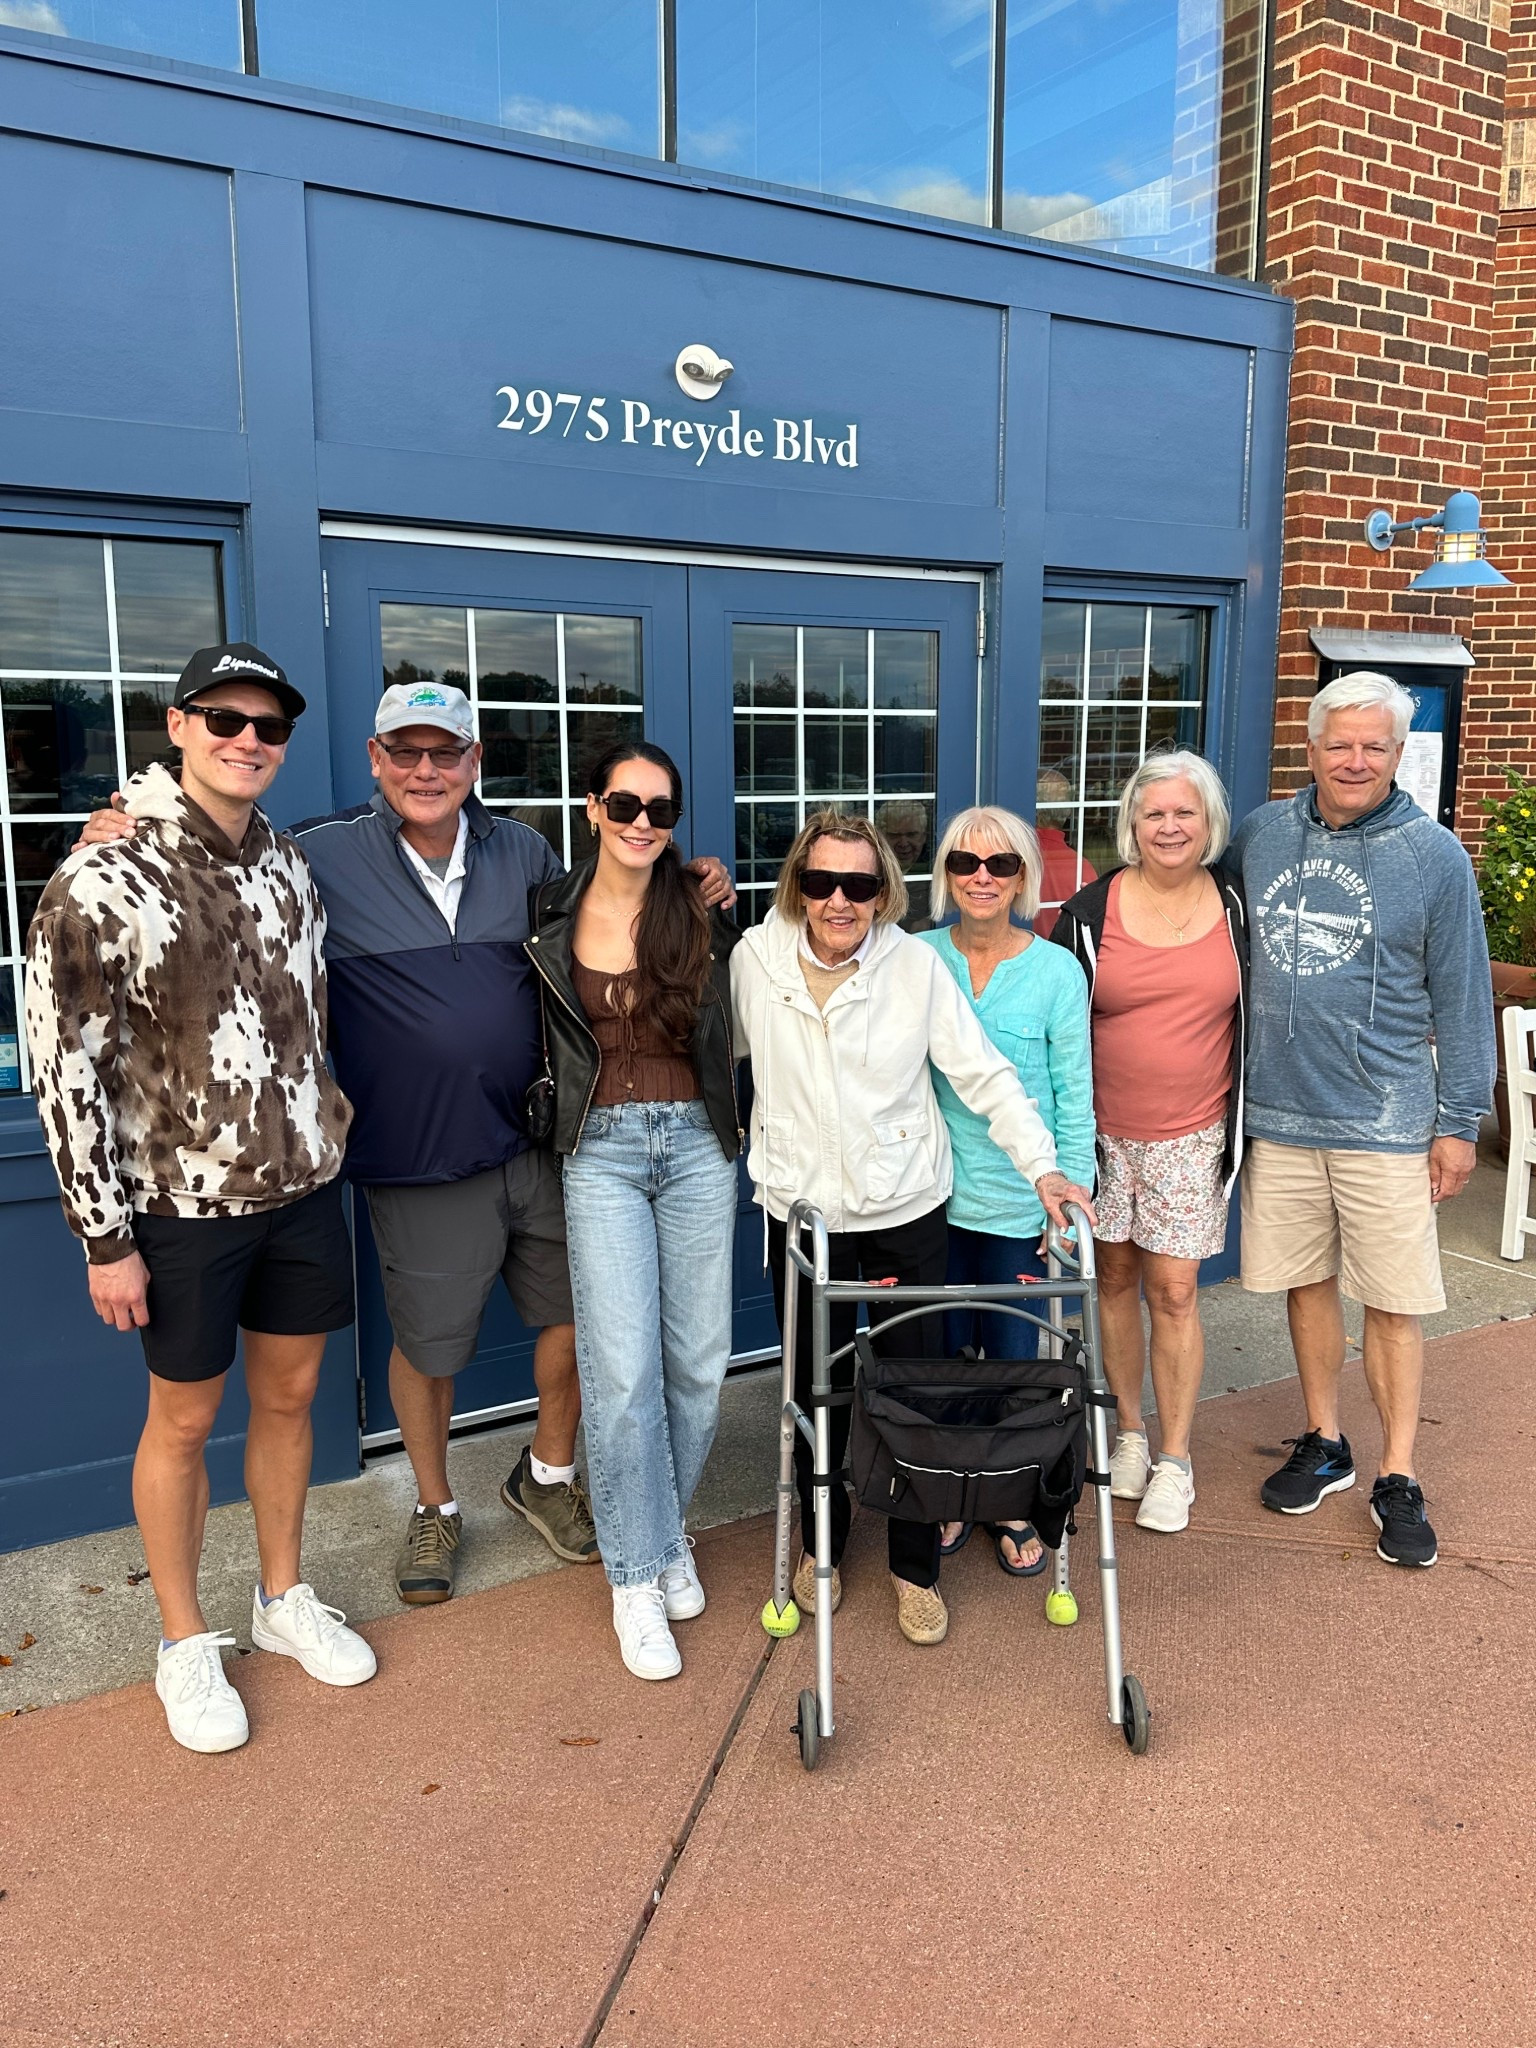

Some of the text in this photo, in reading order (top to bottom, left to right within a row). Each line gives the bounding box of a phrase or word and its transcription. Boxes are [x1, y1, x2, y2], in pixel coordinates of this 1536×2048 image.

[496, 386, 859, 468] 2975 Preyde Blvd
[1263, 868, 1292, 900] GRAND
[1334, 863, 1368, 894] BEACH
[1326, 958, 1343, 971] THE
